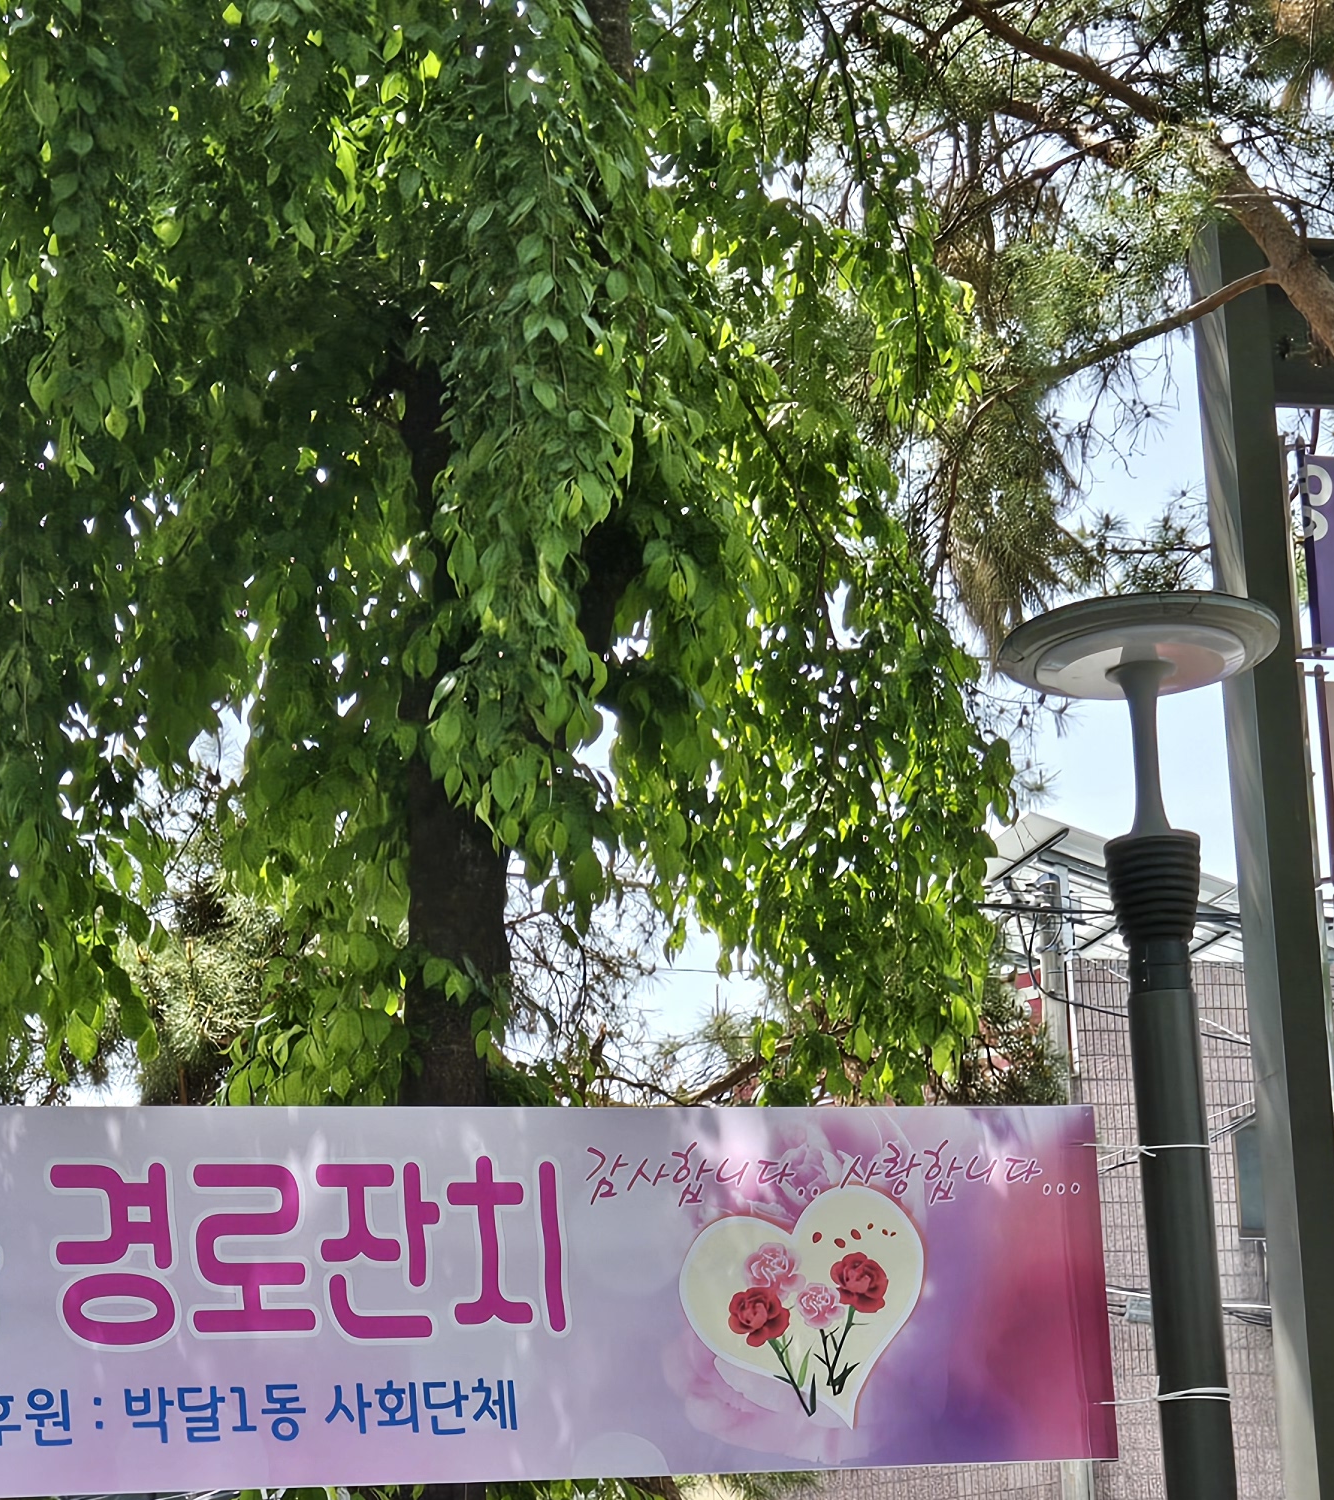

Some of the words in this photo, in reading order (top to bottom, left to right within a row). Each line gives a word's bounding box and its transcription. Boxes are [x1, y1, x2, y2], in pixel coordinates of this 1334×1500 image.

[49, 1155, 569, 1344] 경로잔치
[123, 1383, 307, 1443] 박달1동
[324, 1377, 518, 1435] 사회단체
